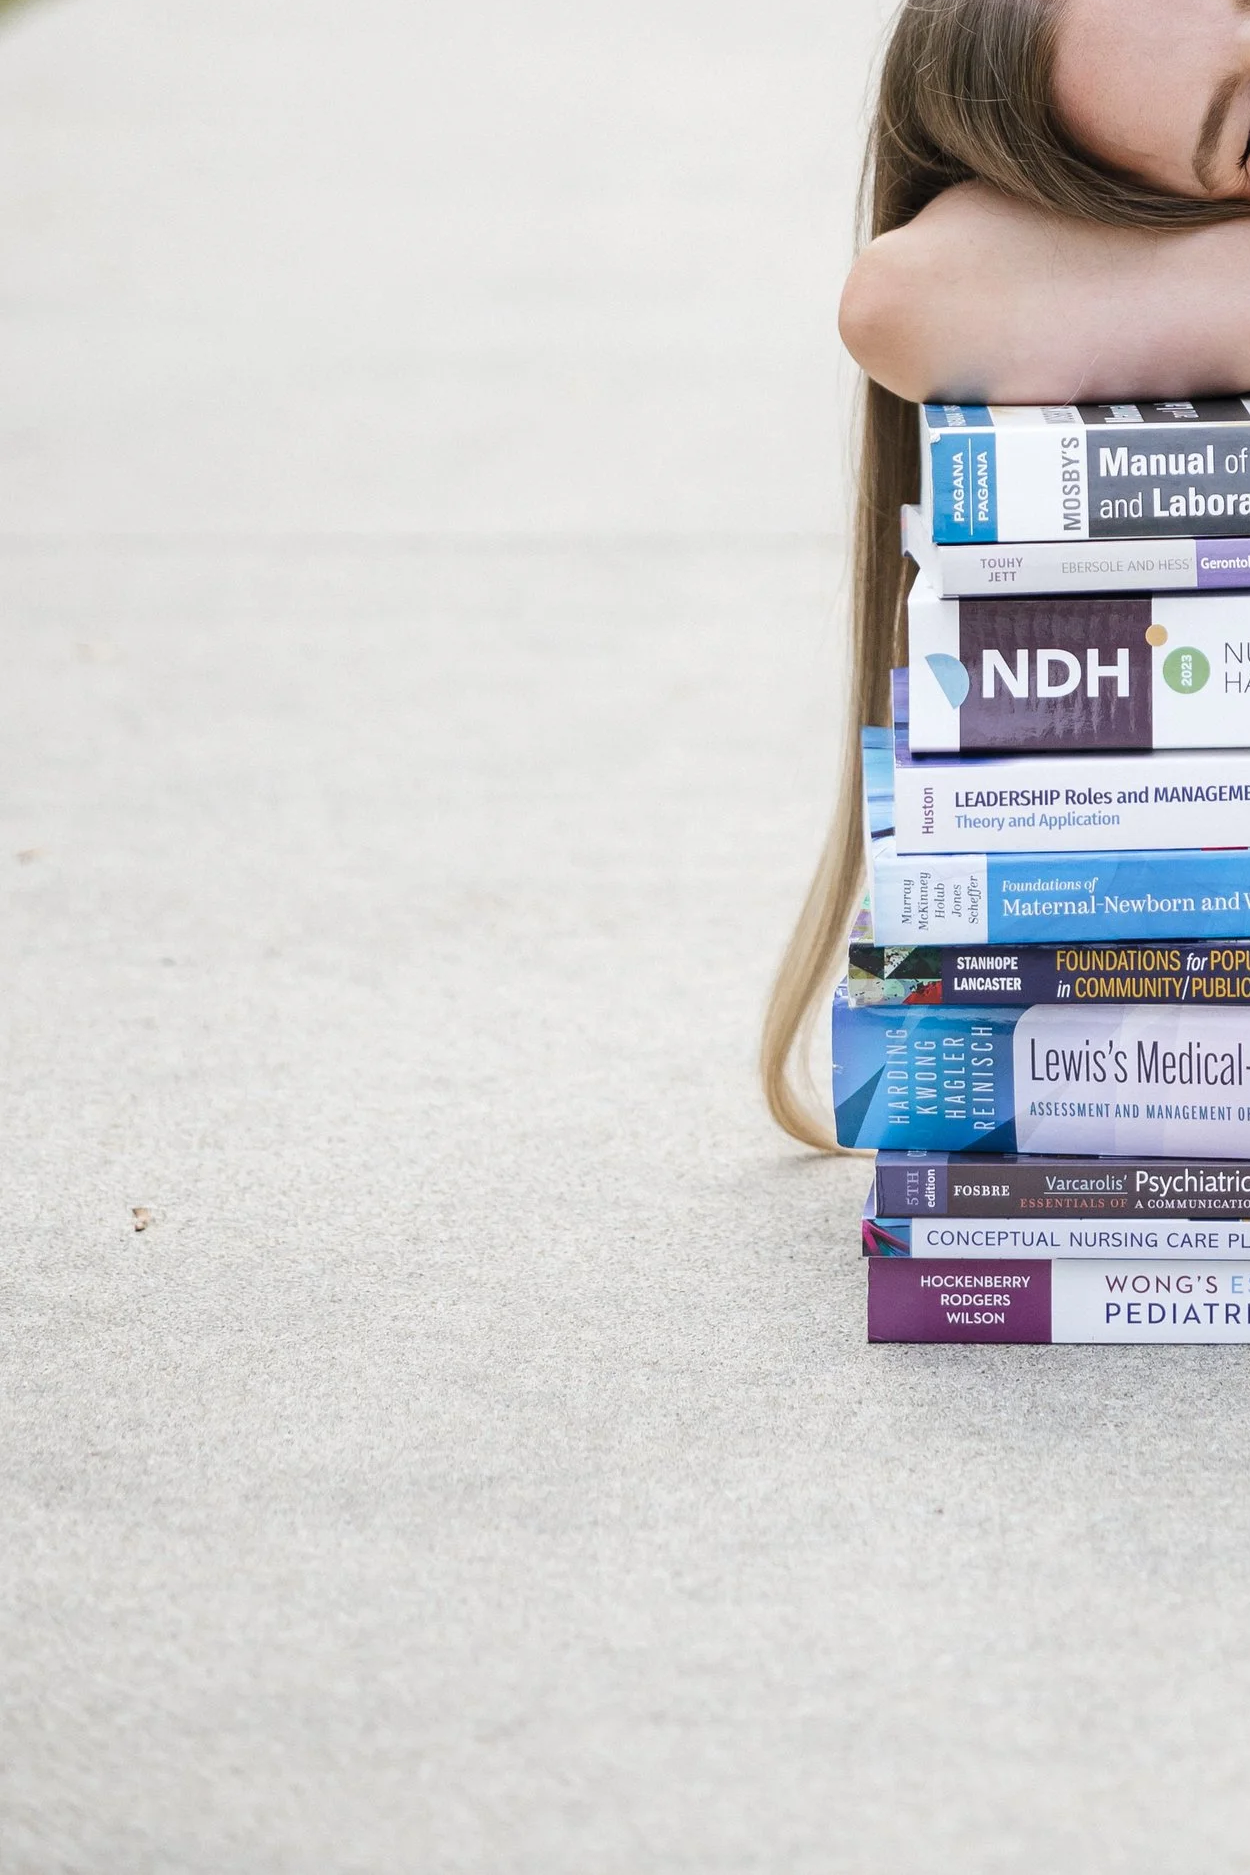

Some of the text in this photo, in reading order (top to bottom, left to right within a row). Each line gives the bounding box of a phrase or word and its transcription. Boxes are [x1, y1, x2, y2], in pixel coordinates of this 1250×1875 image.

[1099, 444, 1214, 478] Manual
[1225, 448, 1249, 473] of
[953, 451, 965, 523] PAGANA
[977, 451, 989, 522] PAGANA
[1060, 436, 1081, 532] MOSBY'S
[1099, 491, 1144, 519] and
[980, 557, 1024, 570] TOUHY
[988, 571, 1017, 583] JETT
[1061, 560, 1124, 575] EBERSOLE
[1127, 559, 1155, 572] AND
[1158, 557, 1194, 571] HESS'
[982, 647, 1130, 699] NDH
[1181, 654, 1193, 687] 2023
[922, 786, 935, 834] Huston
[955, 789, 1060, 808] LEADERSHIP
[1065, 787, 1113, 806] Roles
[1116, 785, 1149, 804] and
[955, 810, 1120, 832] Theory and Application
[1001, 876, 1099, 894] Foundations of
[901, 879, 915, 925] Murray
[918, 871, 931, 931] McKinney
[935, 882, 945, 919] Holub
[952, 884, 962, 918] Jones
[968, 875, 982, 925] Scheffer
[1003, 893, 1196, 917] Maternal-Newborn
[1201, 891, 1240, 912] and
[956, 956, 1018, 970] STANHOPE
[1056, 950, 1181, 971] FOUNDATIONS
[1186, 952, 1208, 971] for
[953, 977, 1022, 991] LANCASTER
[1056, 980, 1071, 998] in
[1030, 1038, 1127, 1083] Lewis's
[886, 1029, 910, 1124] HARDING
[914, 1041, 938, 1115] KWONG
[943, 1037, 966, 1119] HAGLER
[971, 1026, 995, 1130] REINISCH
[1030, 1101, 1111, 1117] ASSESSMENT
[1115, 1104, 1140, 1119] AND
[1147, 1105, 1232, 1121] MANAGEMENT
[906, 1170, 920, 1206] 5TH
[925, 1169, 936, 1208] edition
[953, 1185, 1010, 1196] FOSBRE
[1045, 1174, 1127, 1191] Varcarolis'
[1020, 1198, 1105, 1209] ESSENTIALS
[1110, 1198, 1128, 1208] OF
[1135, 1199, 1144, 1209] A
[927, 1230, 1061, 1247] CONCEPTUAL
[1070, 1231, 1158, 1248] NURSING
[1166, 1232, 1219, 1248] CARE
[920, 1275, 1031, 1288] HOCKENBERRY
[1105, 1275, 1218, 1294] WONG'S
[940, 1293, 1011, 1306] RODGERS
[946, 1312, 1005, 1324] WILSON
